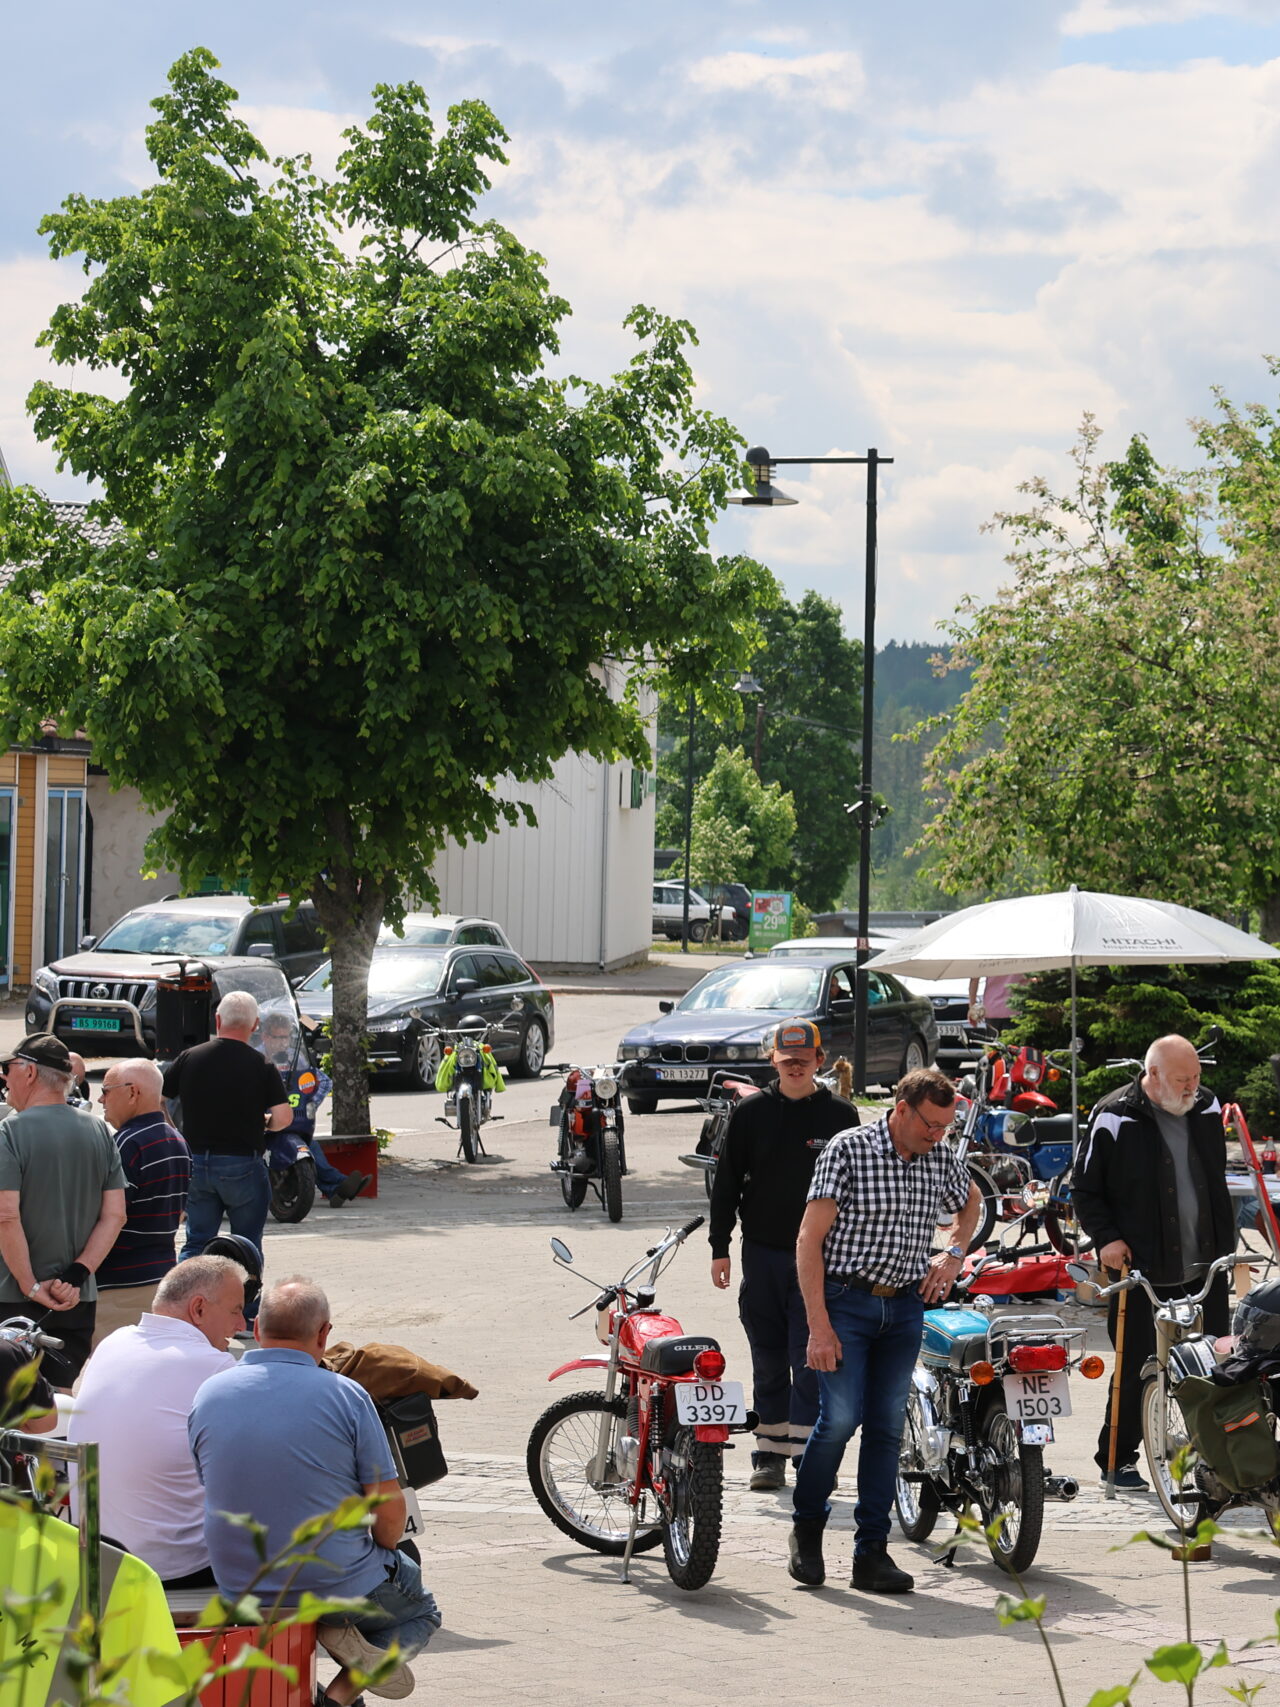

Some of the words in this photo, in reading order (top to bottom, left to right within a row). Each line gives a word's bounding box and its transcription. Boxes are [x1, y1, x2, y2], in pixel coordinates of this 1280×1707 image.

[695, 1385, 724, 1402] DD
[1022, 1376, 1050, 1395] NE
[686, 1404, 738, 1423] 3397
[1016, 1397, 1062, 1418] 1503
[404, 1515, 418, 1534] 4
